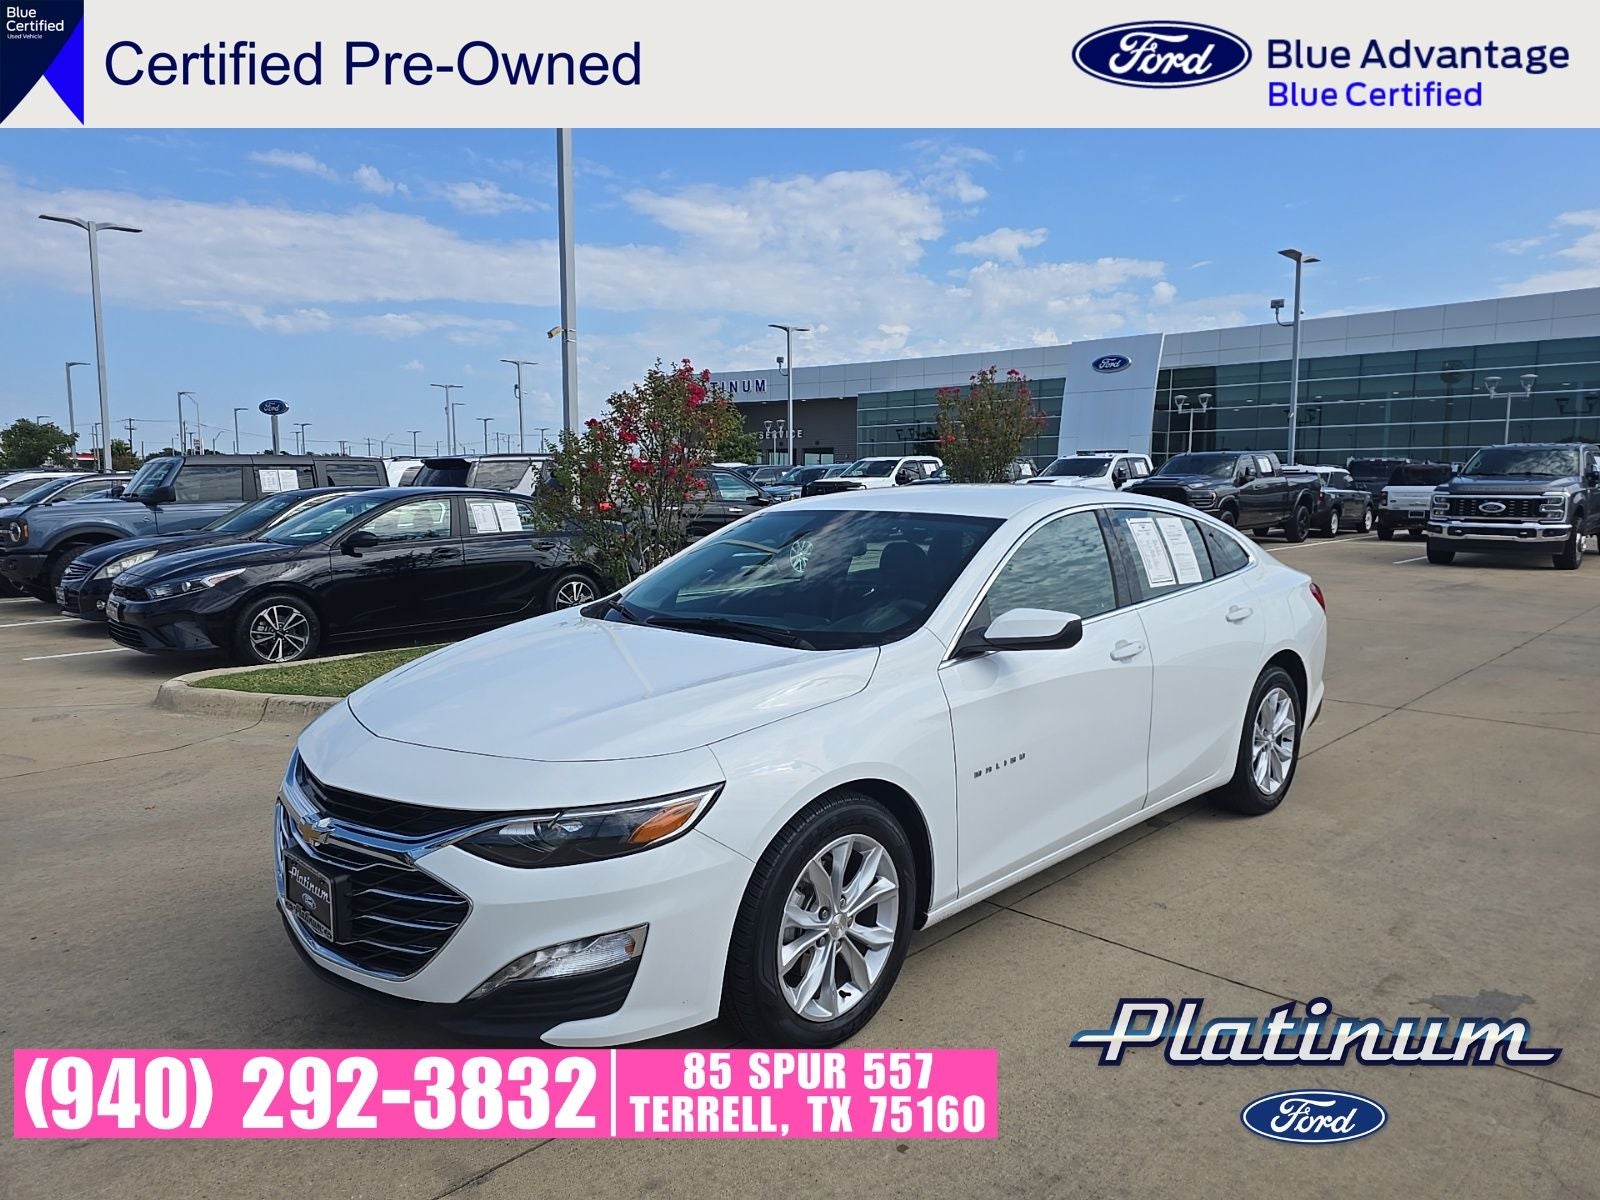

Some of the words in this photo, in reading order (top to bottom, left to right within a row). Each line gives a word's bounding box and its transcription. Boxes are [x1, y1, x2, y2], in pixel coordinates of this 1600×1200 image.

[1099, 358, 1121, 369] Ford
[973, 752, 1026, 779] MALIBU
[288, 866, 332, 904] Platinum
